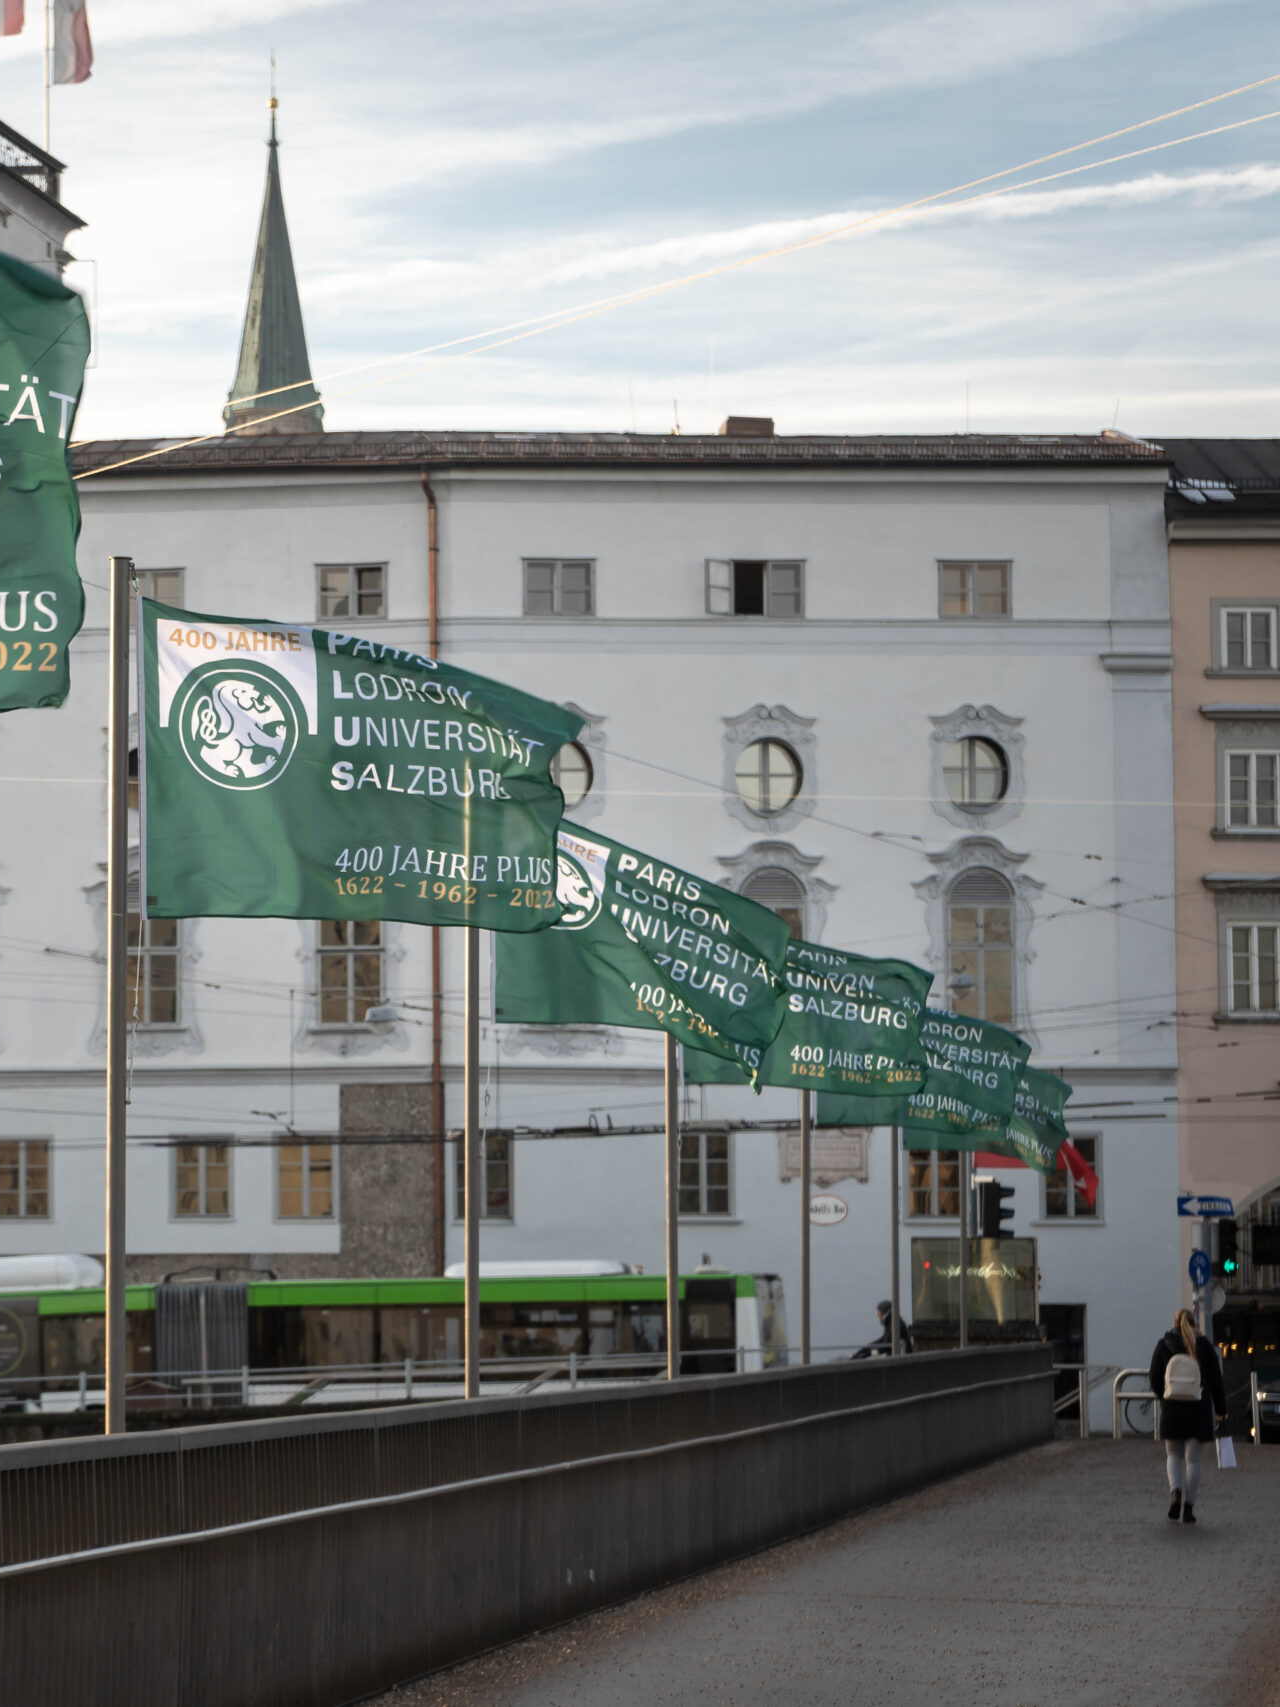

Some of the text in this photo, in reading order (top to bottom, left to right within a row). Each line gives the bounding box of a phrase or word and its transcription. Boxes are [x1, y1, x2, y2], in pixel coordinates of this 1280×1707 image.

[169, 628, 302, 652] 400 JAHRE
[332, 670, 472, 710] LODRON
[333, 716, 545, 768] UNIVERSITÄT
[335, 845, 552, 885] 400 JAHRE PLUS
[617, 853, 701, 901] PARIS
[334, 875, 384, 896] 1622
[416, 880, 477, 905] 1962
[615, 880, 730, 936] LODRON
[652, 952, 749, 1007] ZBURG
[788, 993, 908, 1030] SALZBURG
[921, 1021, 983, 1043] DRON
[790, 1044, 824, 1064] 400
[826, 1048, 873, 1071] JAHRE
[919, 1038, 1022, 1072] VERSITÄT
[791, 1062, 826, 1078] 1622
[840, 1069, 872, 1084] 1962
[885, 1070, 922, 1083] 2022
[907, 1093, 934, 1108] 400
[936, 1094, 972, 1118] JAHRE
